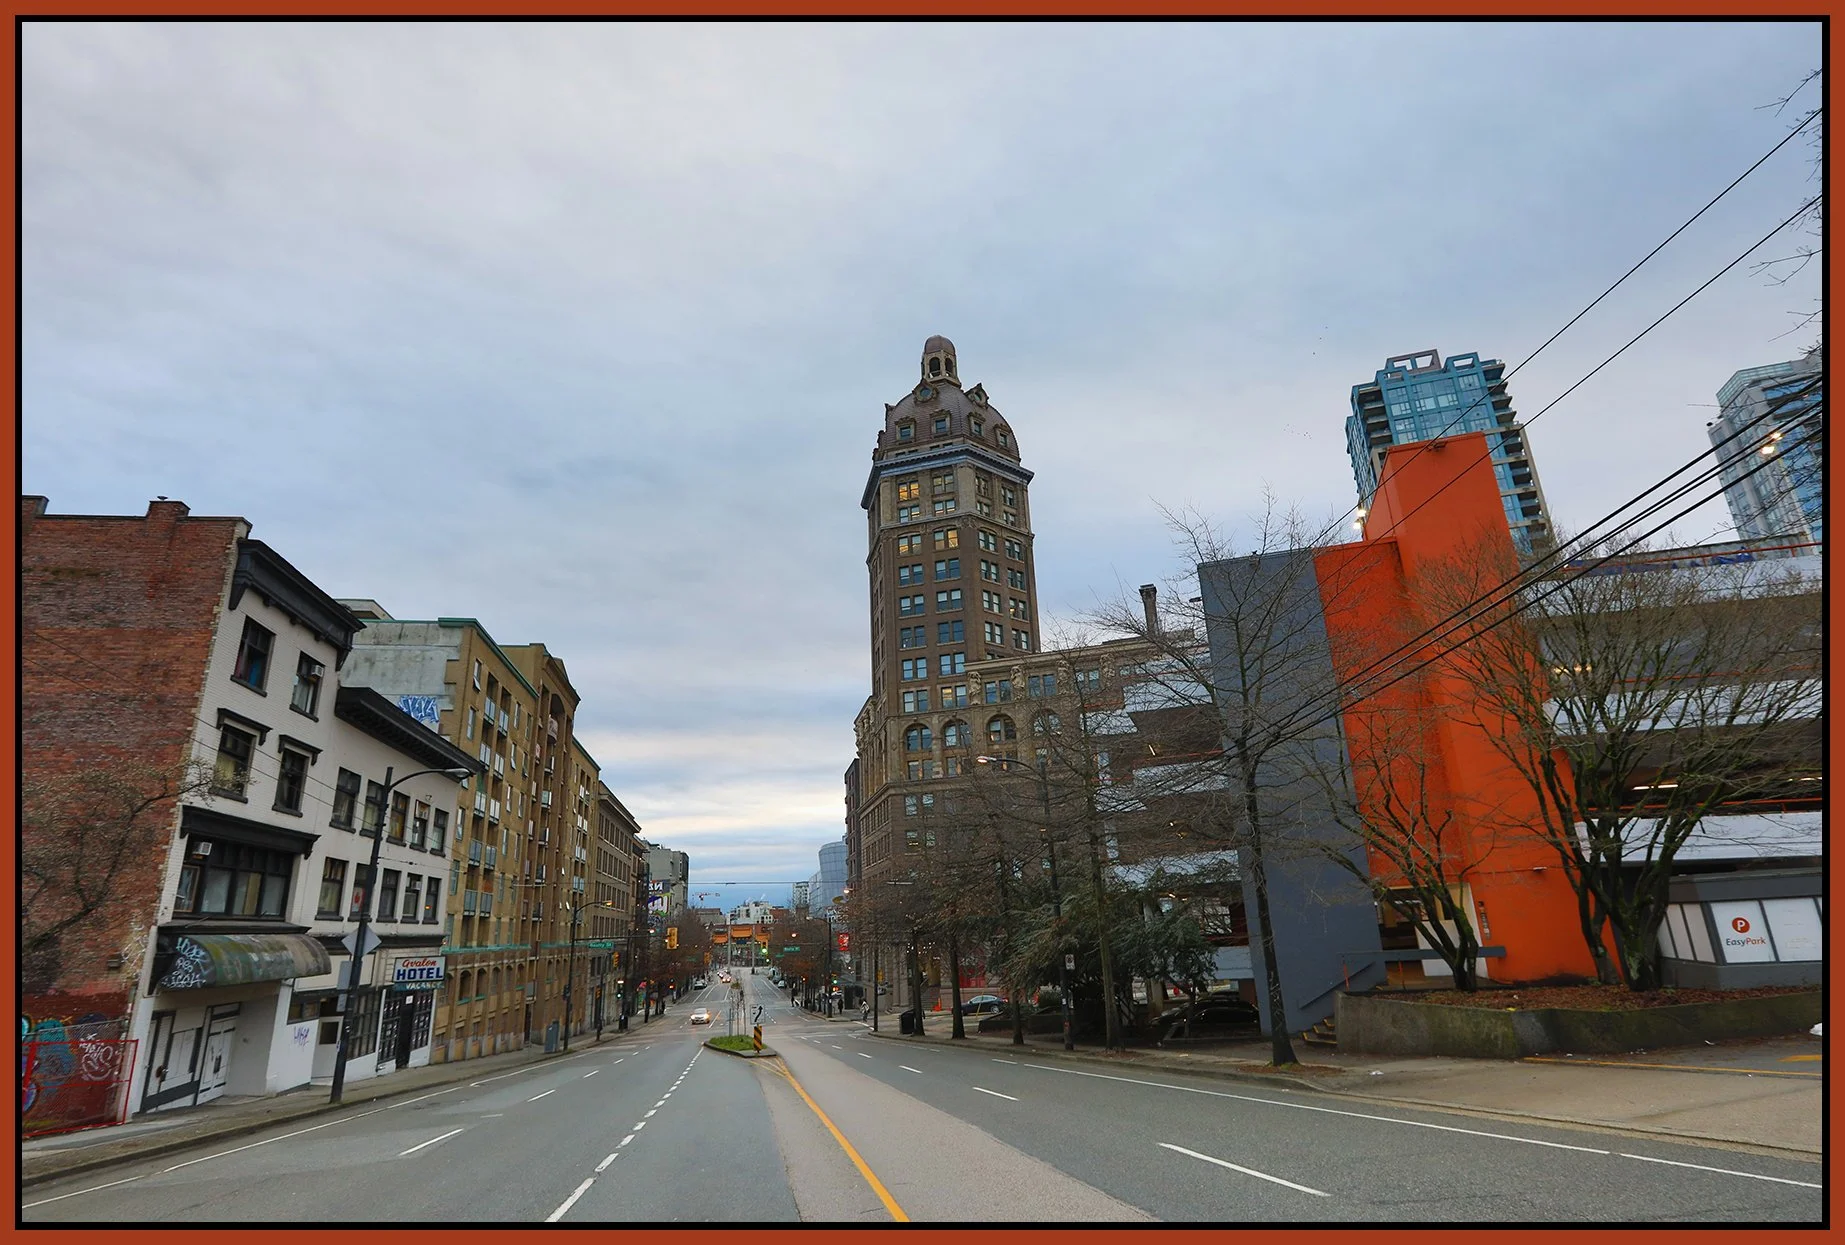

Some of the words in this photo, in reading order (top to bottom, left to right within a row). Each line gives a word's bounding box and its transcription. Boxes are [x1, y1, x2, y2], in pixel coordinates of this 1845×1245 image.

[1737, 920, 1746, 931] P
[1726, 936, 1766, 947] EasyPark
[396, 967, 443, 981] HOTEL
[406, 981, 445, 989] VACANCY
